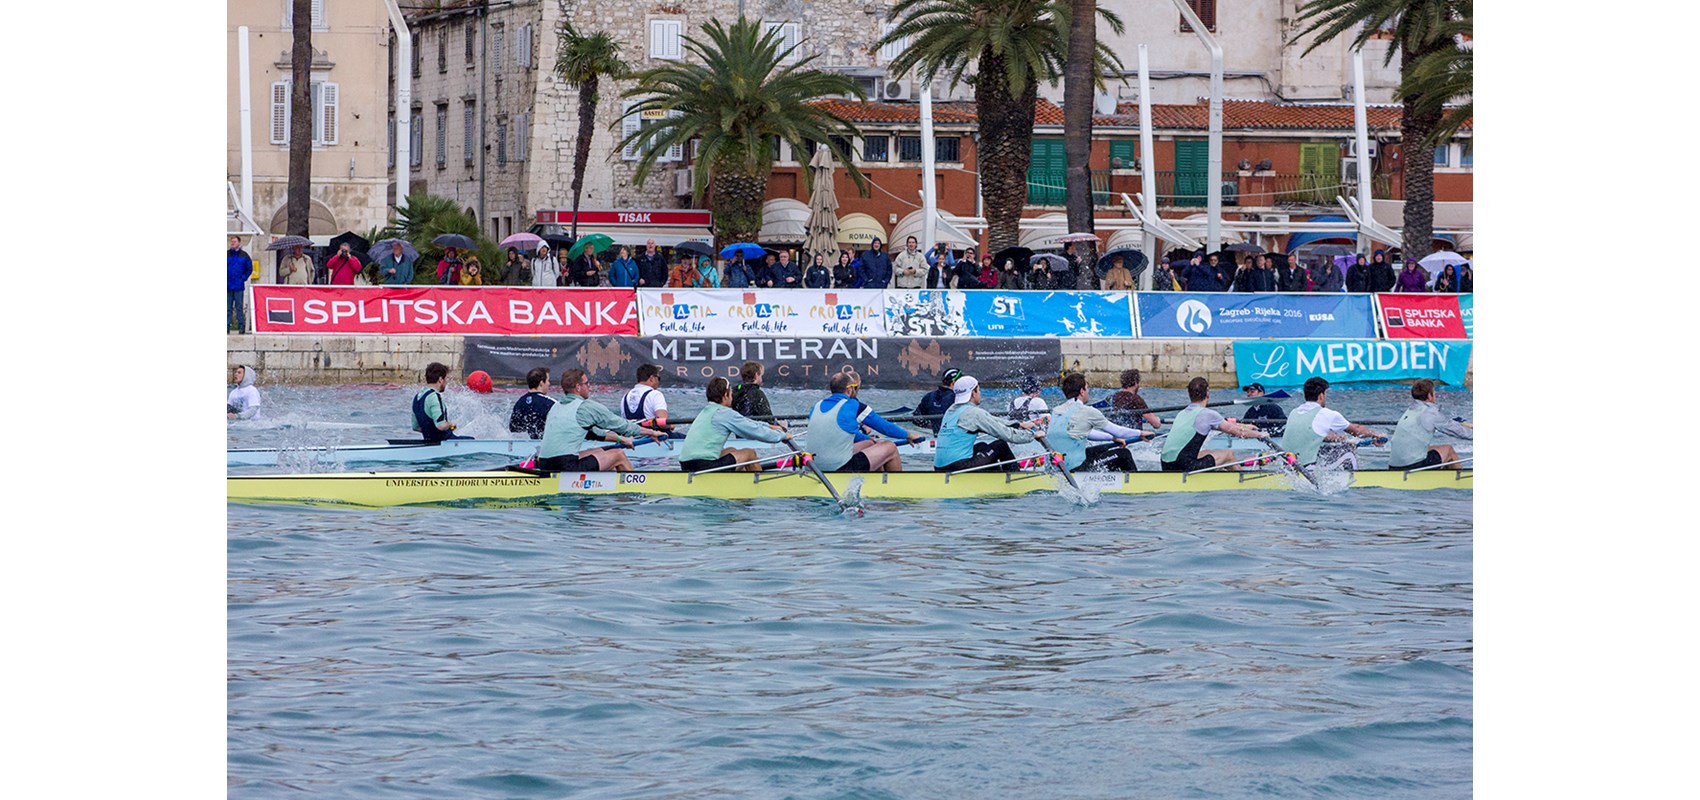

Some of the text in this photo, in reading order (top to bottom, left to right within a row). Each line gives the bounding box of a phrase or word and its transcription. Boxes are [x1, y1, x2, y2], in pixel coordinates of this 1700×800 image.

[618, 213, 651, 222] TISAK
[303, 299, 638, 326] SPLITSKA BANKA
[646, 303, 718, 320] CROATIA
[728, 303, 799, 319] CROATIA
[809, 304, 880, 320] CROATIA
[994, 297, 1019, 315] ST
[1219, 307, 1303, 319] Zagreb Rijeka 2016
[1309, 313, 1335, 321] EUSA
[1404, 309, 1456, 318] SPLITSKA
[691, 321, 706, 333] life
[774, 320, 788, 333] life
[854, 322, 868, 335] life
[1407, 318, 1445, 328] BANKA
[652, 338, 878, 361] MEDITERAN
[1251, 341, 1449, 379] Le MERIDIEN
[653, 364, 879, 378] RODCTION
[440, 479, 489, 487] STUDIORUM
[490, 479, 541, 487] SPALATENSIS
[626, 474, 646, 484] CRO
